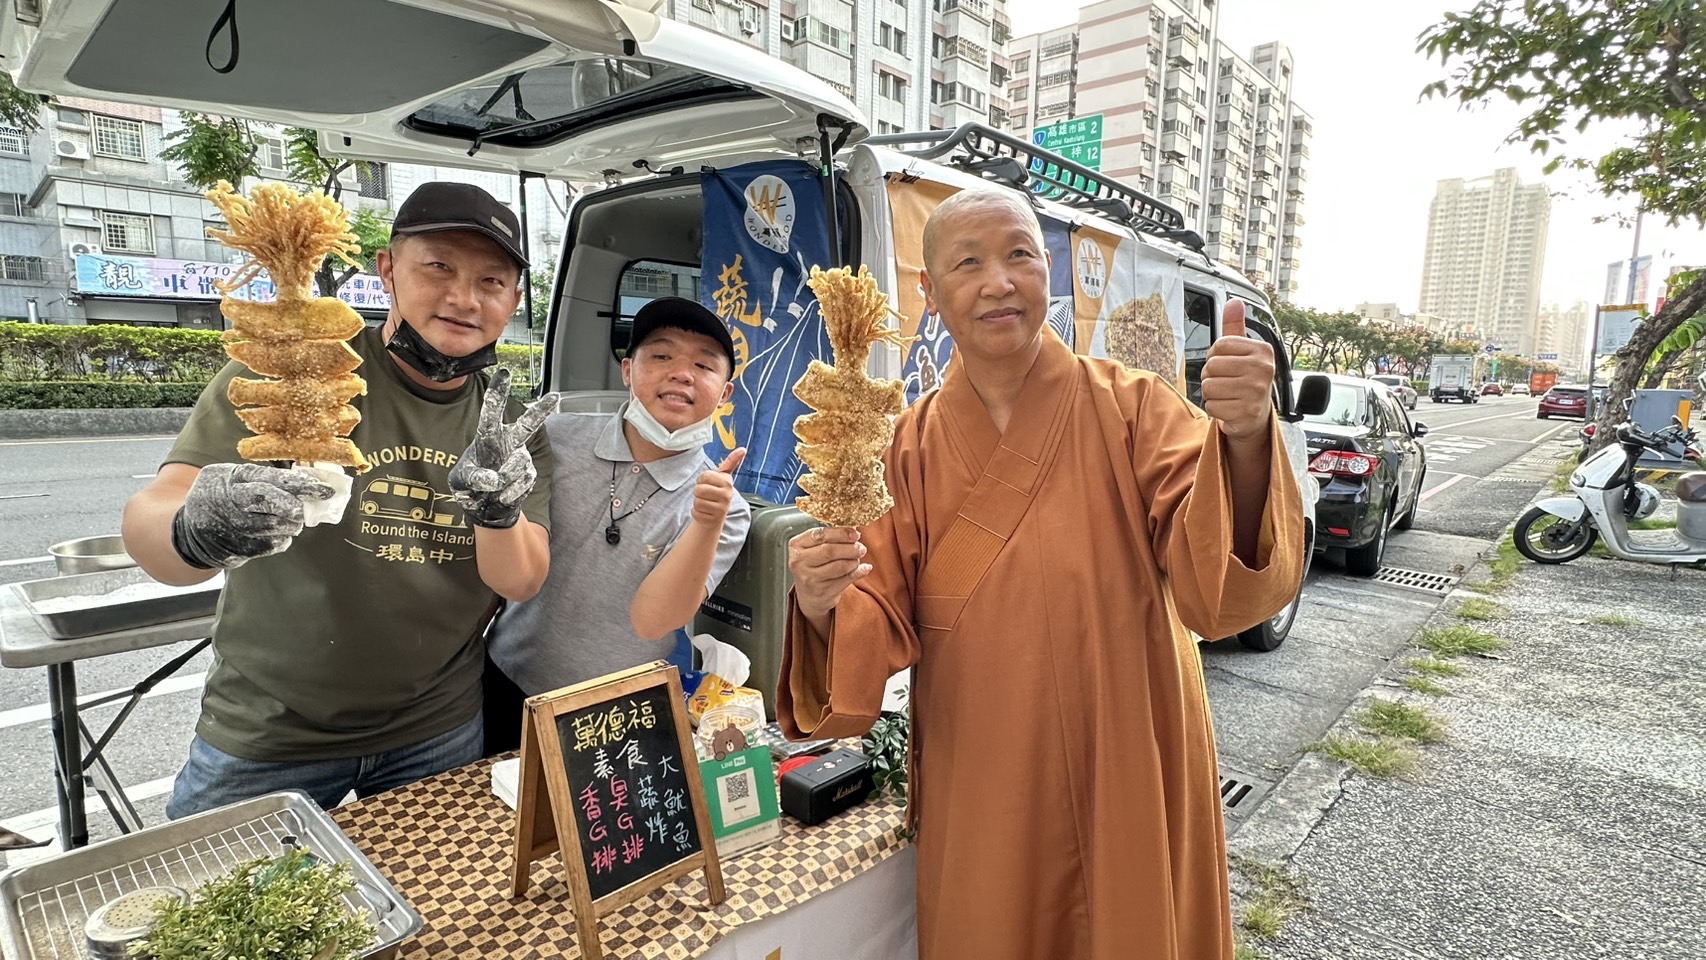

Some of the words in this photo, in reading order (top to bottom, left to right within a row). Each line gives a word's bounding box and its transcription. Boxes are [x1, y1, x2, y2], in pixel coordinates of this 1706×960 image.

[1047, 121, 1087, 138] 高雄市區
[1090, 121, 1098, 135] 2
[1087, 146, 1099, 161] 12
[361, 520, 406, 535] Round
[407, 526, 429, 540] the
[432, 529, 475, 546] Island
[375, 543, 454, 564] 環島中
[571, 699, 657, 752] 萬德福
[593, 739, 649, 780] 素食
[721, 760, 734, 769] LINE
